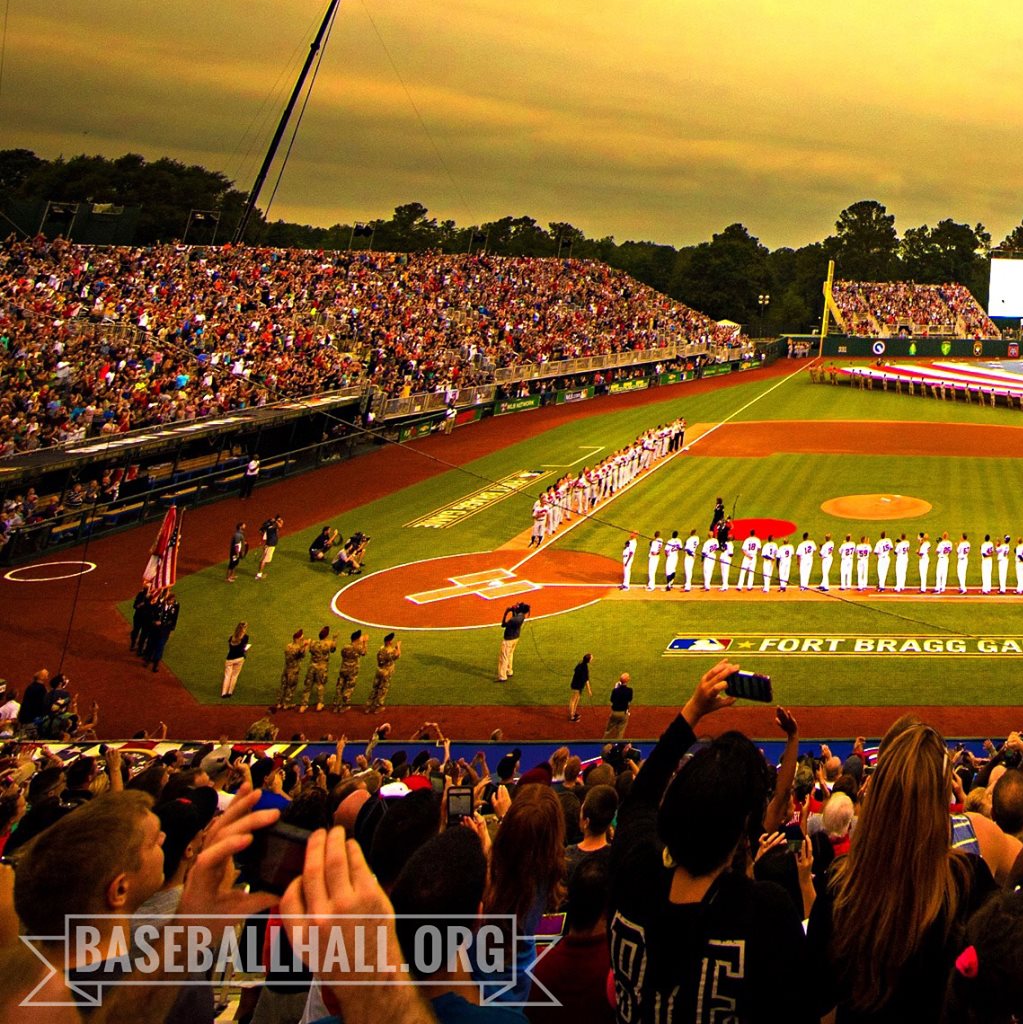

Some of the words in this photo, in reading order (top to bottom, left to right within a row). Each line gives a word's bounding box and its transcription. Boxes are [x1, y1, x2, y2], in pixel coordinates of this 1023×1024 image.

[748, 543, 756, 551] 18
[758, 638, 845, 652] FORT
[853, 638, 966, 652] BRAGG
